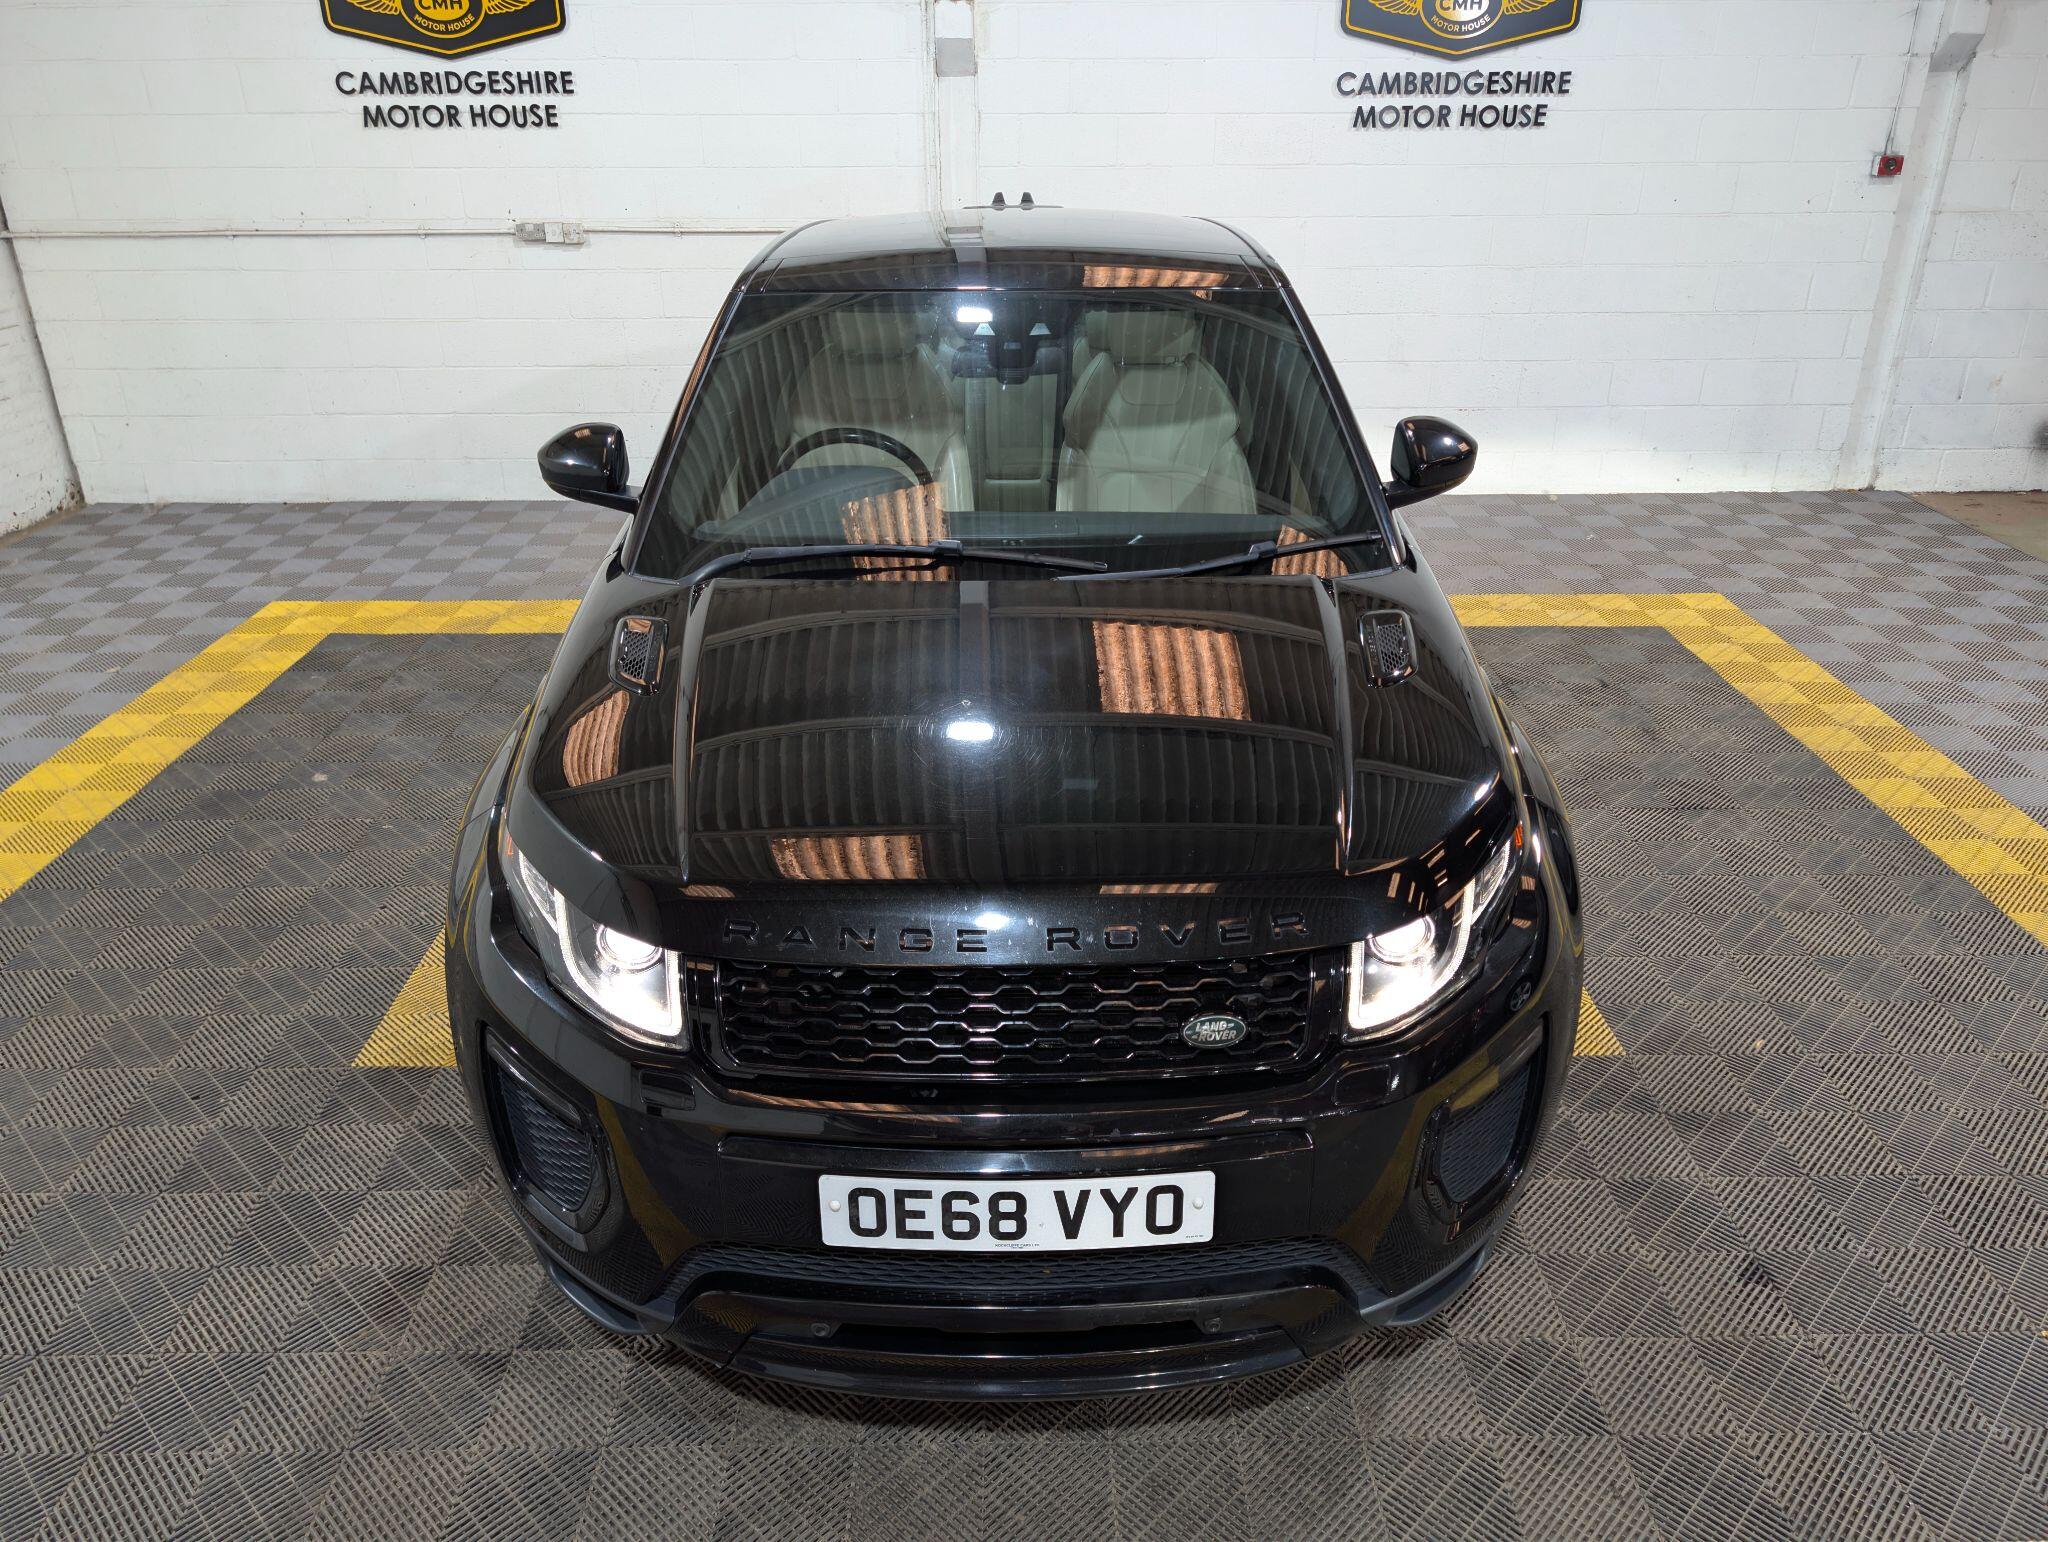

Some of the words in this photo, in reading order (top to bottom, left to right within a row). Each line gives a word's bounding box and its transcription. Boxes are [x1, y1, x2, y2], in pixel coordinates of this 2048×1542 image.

[418, 0, 463, 10] CMH
[1439, 0, 1483, 11] CMH
[413, 14, 446, 32] MOTOR
[447, 13, 475, 32] HOUSE
[1431, 15, 1460, 32] MOTOR
[1461, 14, 1491, 32] HOUSE
[335, 70, 575, 95] CAMBRIDGESHIRE
[1336, 70, 1573, 96] CAMBRIDGESHIRE
[362, 104, 462, 128] MOTOR
[470, 103, 559, 128] HOUSE
[1352, 104, 1452, 129] MOTOR
[1459, 103, 1549, 127] HOUSE
[721, 918, 988, 953] RANGE
[1045, 911, 1310, 952] ROVER
[1195, 1020, 1228, 1033] LAND
[1198, 1029, 1237, 1042] ROVER
[847, 1187, 1029, 1241] OE68
[1052, 1184, 1185, 1240] VYO
